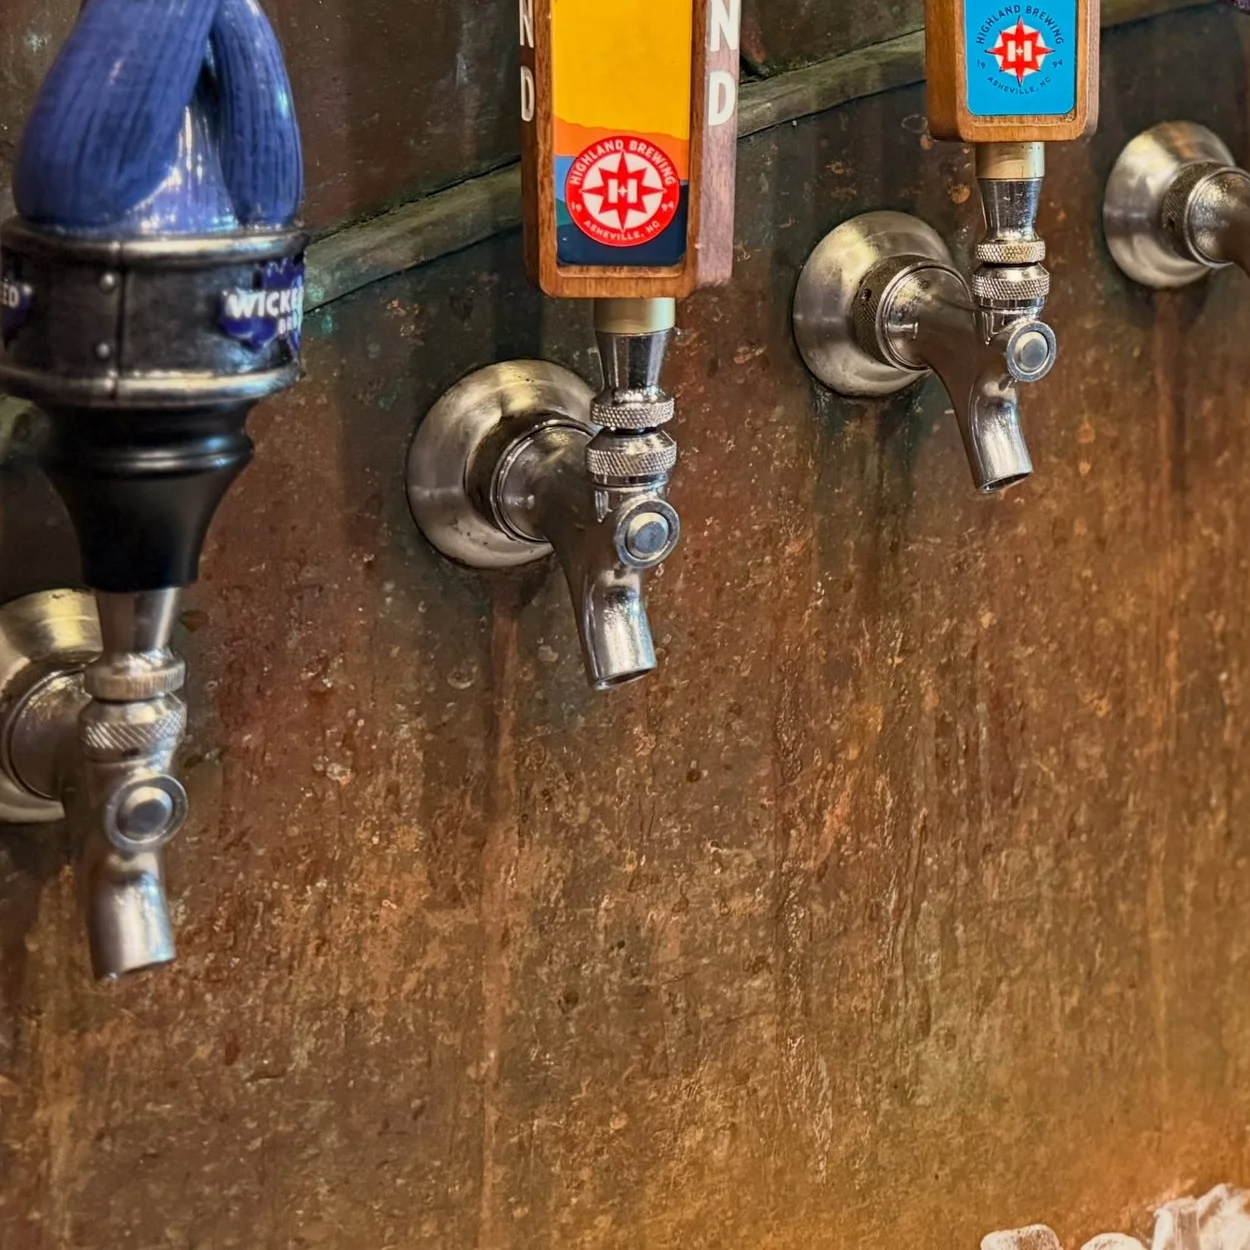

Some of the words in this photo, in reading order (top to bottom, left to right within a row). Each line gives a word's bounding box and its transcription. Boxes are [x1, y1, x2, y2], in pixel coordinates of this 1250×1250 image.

[976, 4, 1020, 44] HIGHLAND
[1025, 5, 1064, 44] BREWING
[569, 139, 624, 185] HIGHLAND
[629, 140, 676, 186] BREWING
